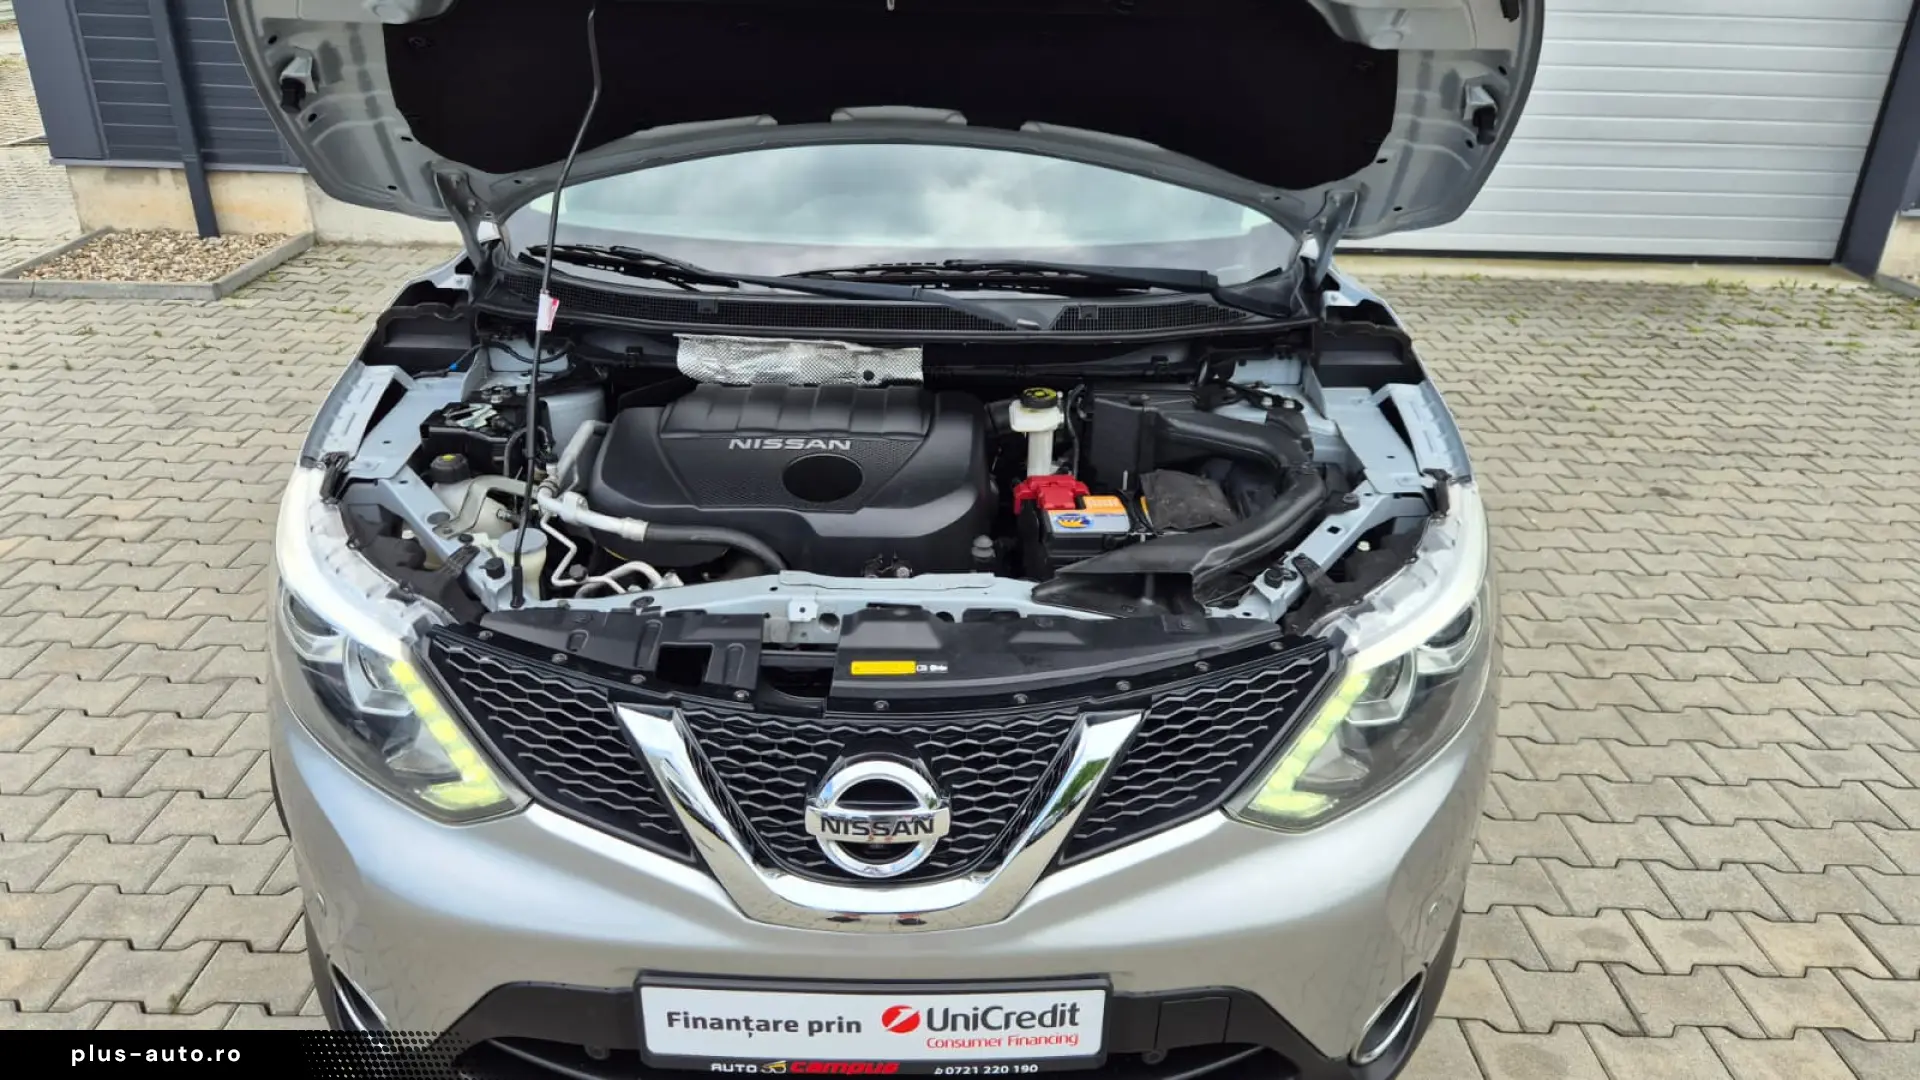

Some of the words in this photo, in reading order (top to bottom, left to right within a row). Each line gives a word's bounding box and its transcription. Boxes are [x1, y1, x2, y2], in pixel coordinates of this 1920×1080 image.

[729, 438, 851, 450] NISSAN
[821, 817, 934, 836] NISSAN
[667, 1011, 799, 1039] Finanțare
[808, 1015, 862, 1037] prin
[927, 1003, 1080, 1031] UniCredit
[927, 1036, 1003, 1049] Consumer
[1008, 1032, 1079, 1048] Financing
[710, 1062, 757, 1073] AUTO
[945, 1064, 979, 1075] 0721
[983, 1064, 1009, 1074] 220
[1014, 1063, 1039, 1073] 190
